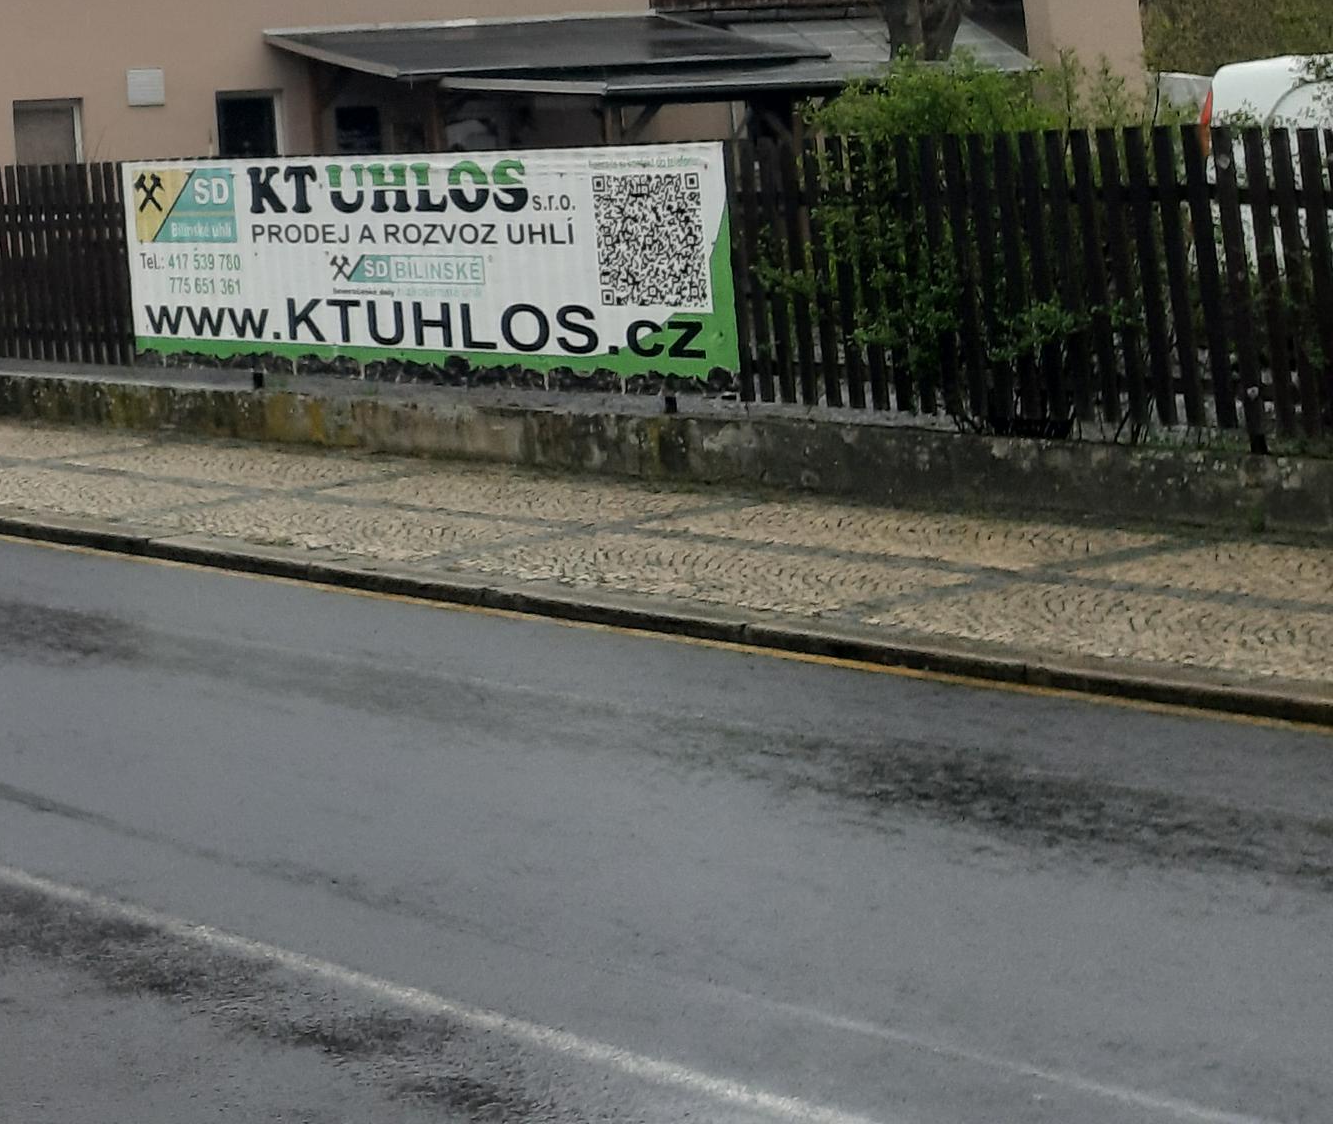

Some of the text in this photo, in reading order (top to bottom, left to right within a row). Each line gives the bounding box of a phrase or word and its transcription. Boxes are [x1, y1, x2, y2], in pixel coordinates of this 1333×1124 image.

[194, 177, 229, 205] SD
[533, 194, 576, 211] s.r.o.
[251, 217, 574, 246] PRODEJ A ROZVOZ UHLÍ
[168, 253, 189, 270] 417
[194, 253, 215, 270] 539
[219, 254, 241, 271] 780
[364, 256, 481, 280] SD BÍLINSKÉ
[169, 277, 241, 295] 775 651 361
[145, 299, 707, 360] www.KTUHLOS.cz
